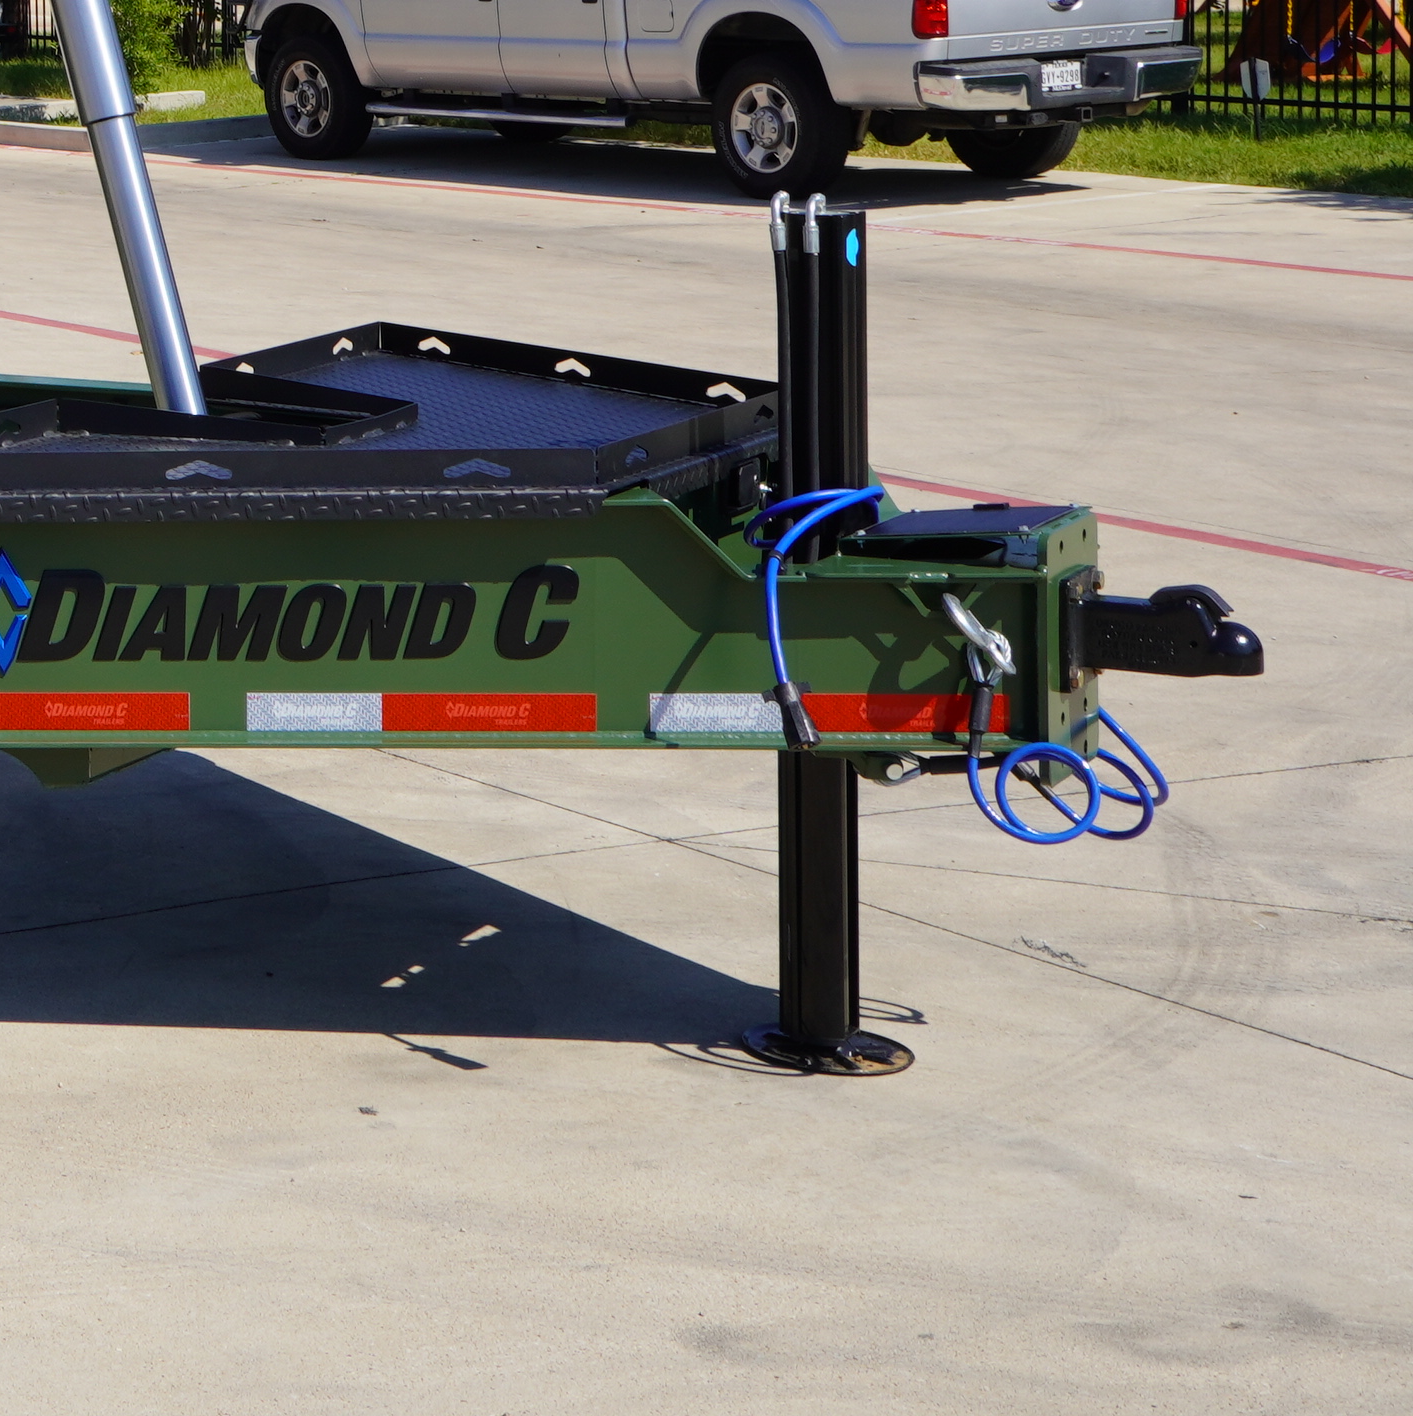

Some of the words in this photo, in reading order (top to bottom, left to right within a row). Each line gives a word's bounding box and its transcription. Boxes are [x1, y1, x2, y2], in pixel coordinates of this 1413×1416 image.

[989, 34, 1065, 52] SUPER
[1078, 27, 1136, 45] DUTY
[16, 568, 477, 662] DIAMOND
[493, 563, 580, 661] C
[50, 703, 115, 716] DIAMOND
[116, 702, 129, 717] C
[454, 704, 517, 718] DIAMOND
[518, 703, 531, 718] C
[681, 702, 747, 718] DIAMOND
